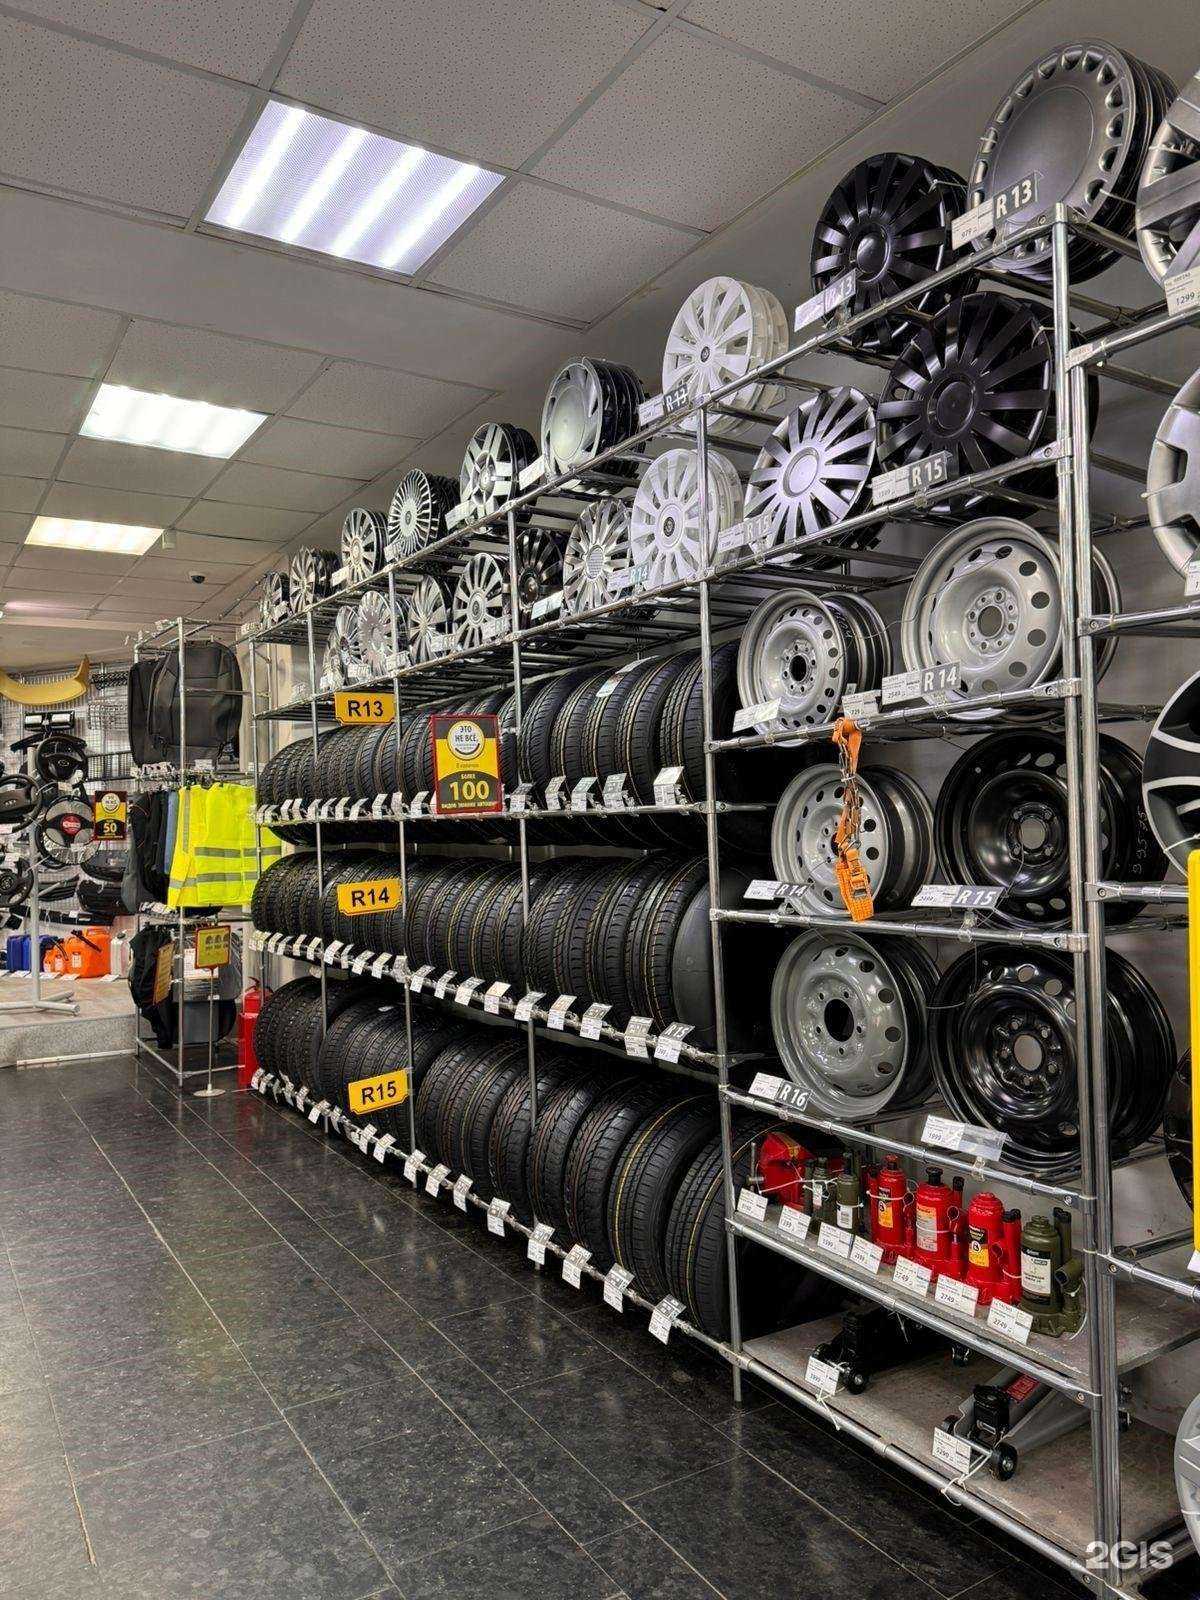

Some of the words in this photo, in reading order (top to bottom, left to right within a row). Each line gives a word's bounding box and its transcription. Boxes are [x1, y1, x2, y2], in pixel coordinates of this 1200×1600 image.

[996, 193, 1008, 219] R
[1011, 179, 1032, 209] 13
[912, 466, 922, 488] R
[924, 458, 943, 482] 15
[923, 671, 935, 692] R
[938, 665, 957, 689] 14
[347, 699, 384, 718] R13
[460, 725, 472, 733] ЭТО
[449, 780, 490, 801] 100
[103, 822, 117, 833] 50
[351, 886, 390, 908] R14
[776, 883, 790, 896] R
[789, 884, 808, 898] 14
[956, 889, 973, 904] R
[973, 890, 997, 906] 15
[361, 1080, 397, 1105] R15
[779, 1083, 792, 1101] R
[791, 1088, 809, 1107] 16
